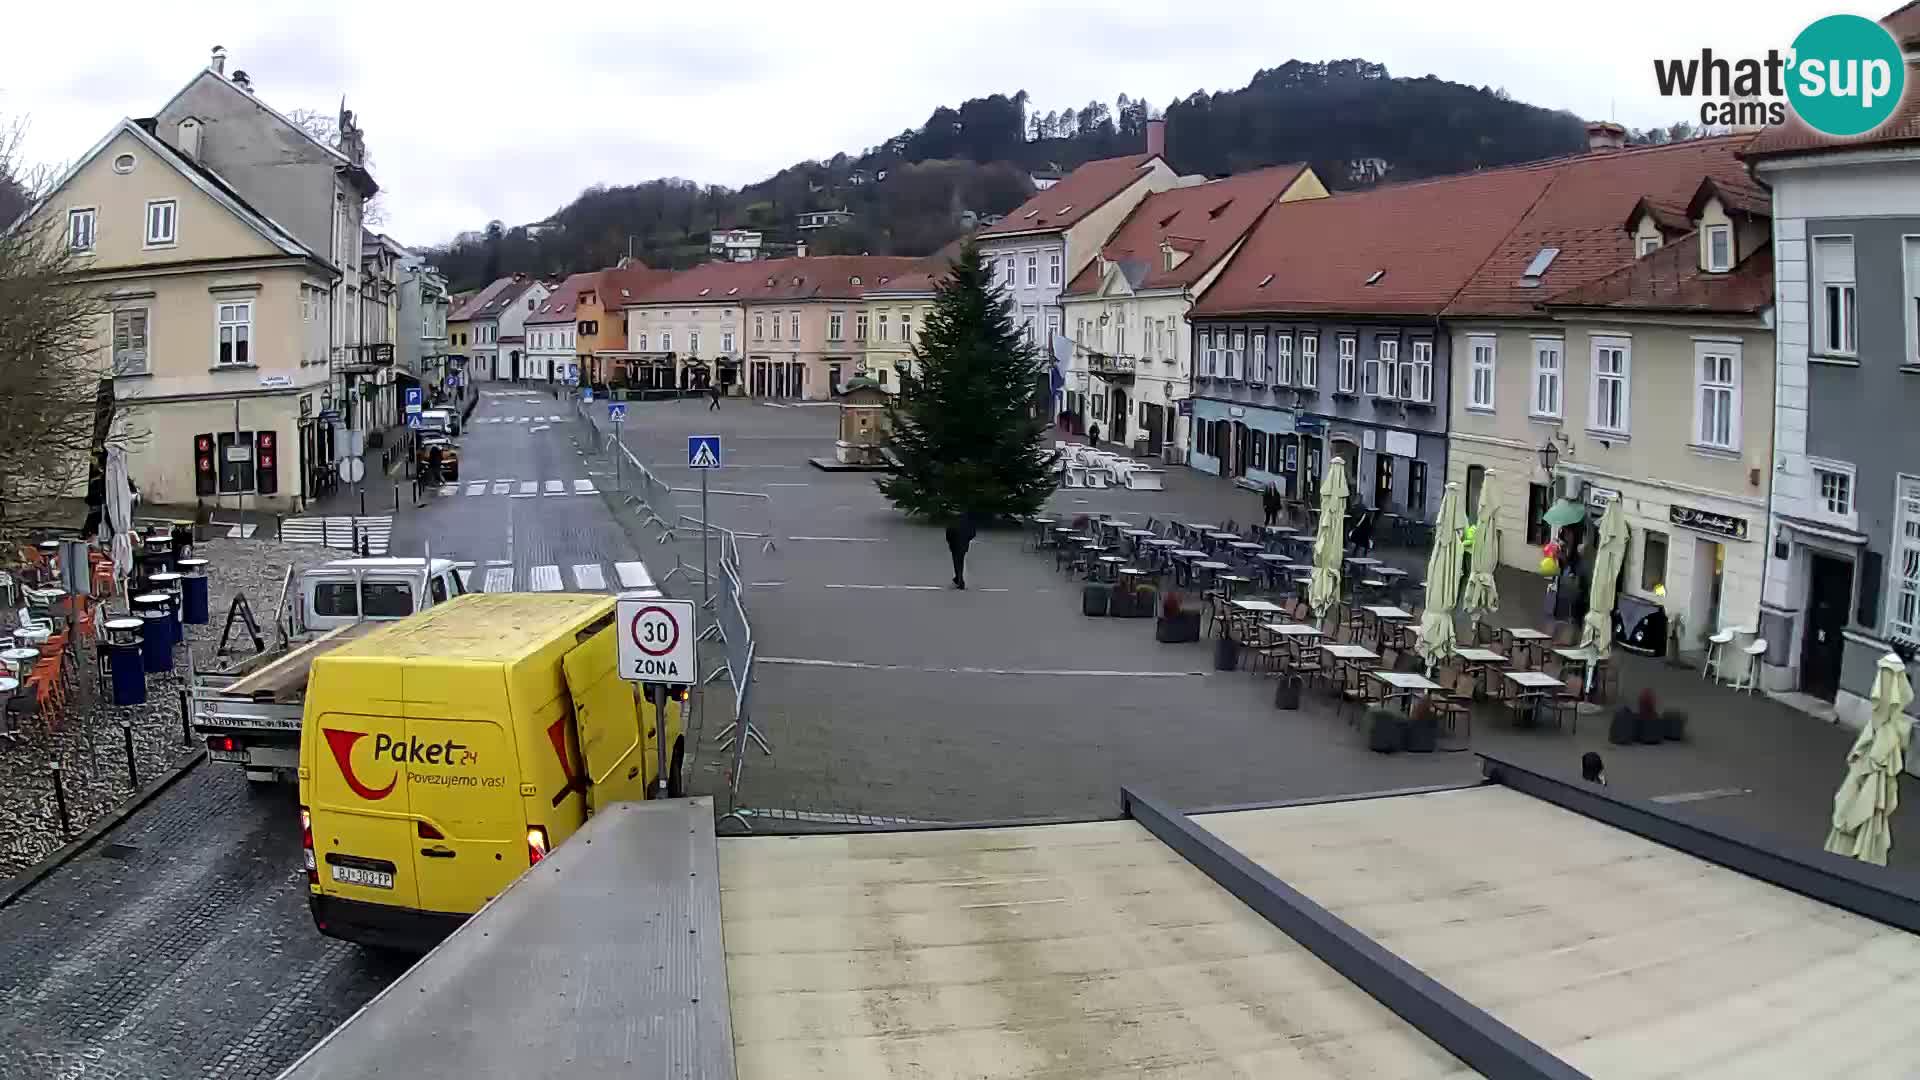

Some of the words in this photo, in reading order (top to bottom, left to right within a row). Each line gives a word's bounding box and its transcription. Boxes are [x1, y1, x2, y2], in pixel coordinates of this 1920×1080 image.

[409, 391, 418, 402] P
[644, 621, 668, 643] 30
[634, 659, 679, 676] ZONA
[374, 733, 467, 766] Paket
[460, 750, 478, 766] 24
[407, 771, 478, 788] Povezujemo
[481, 775, 506, 788] vas!
